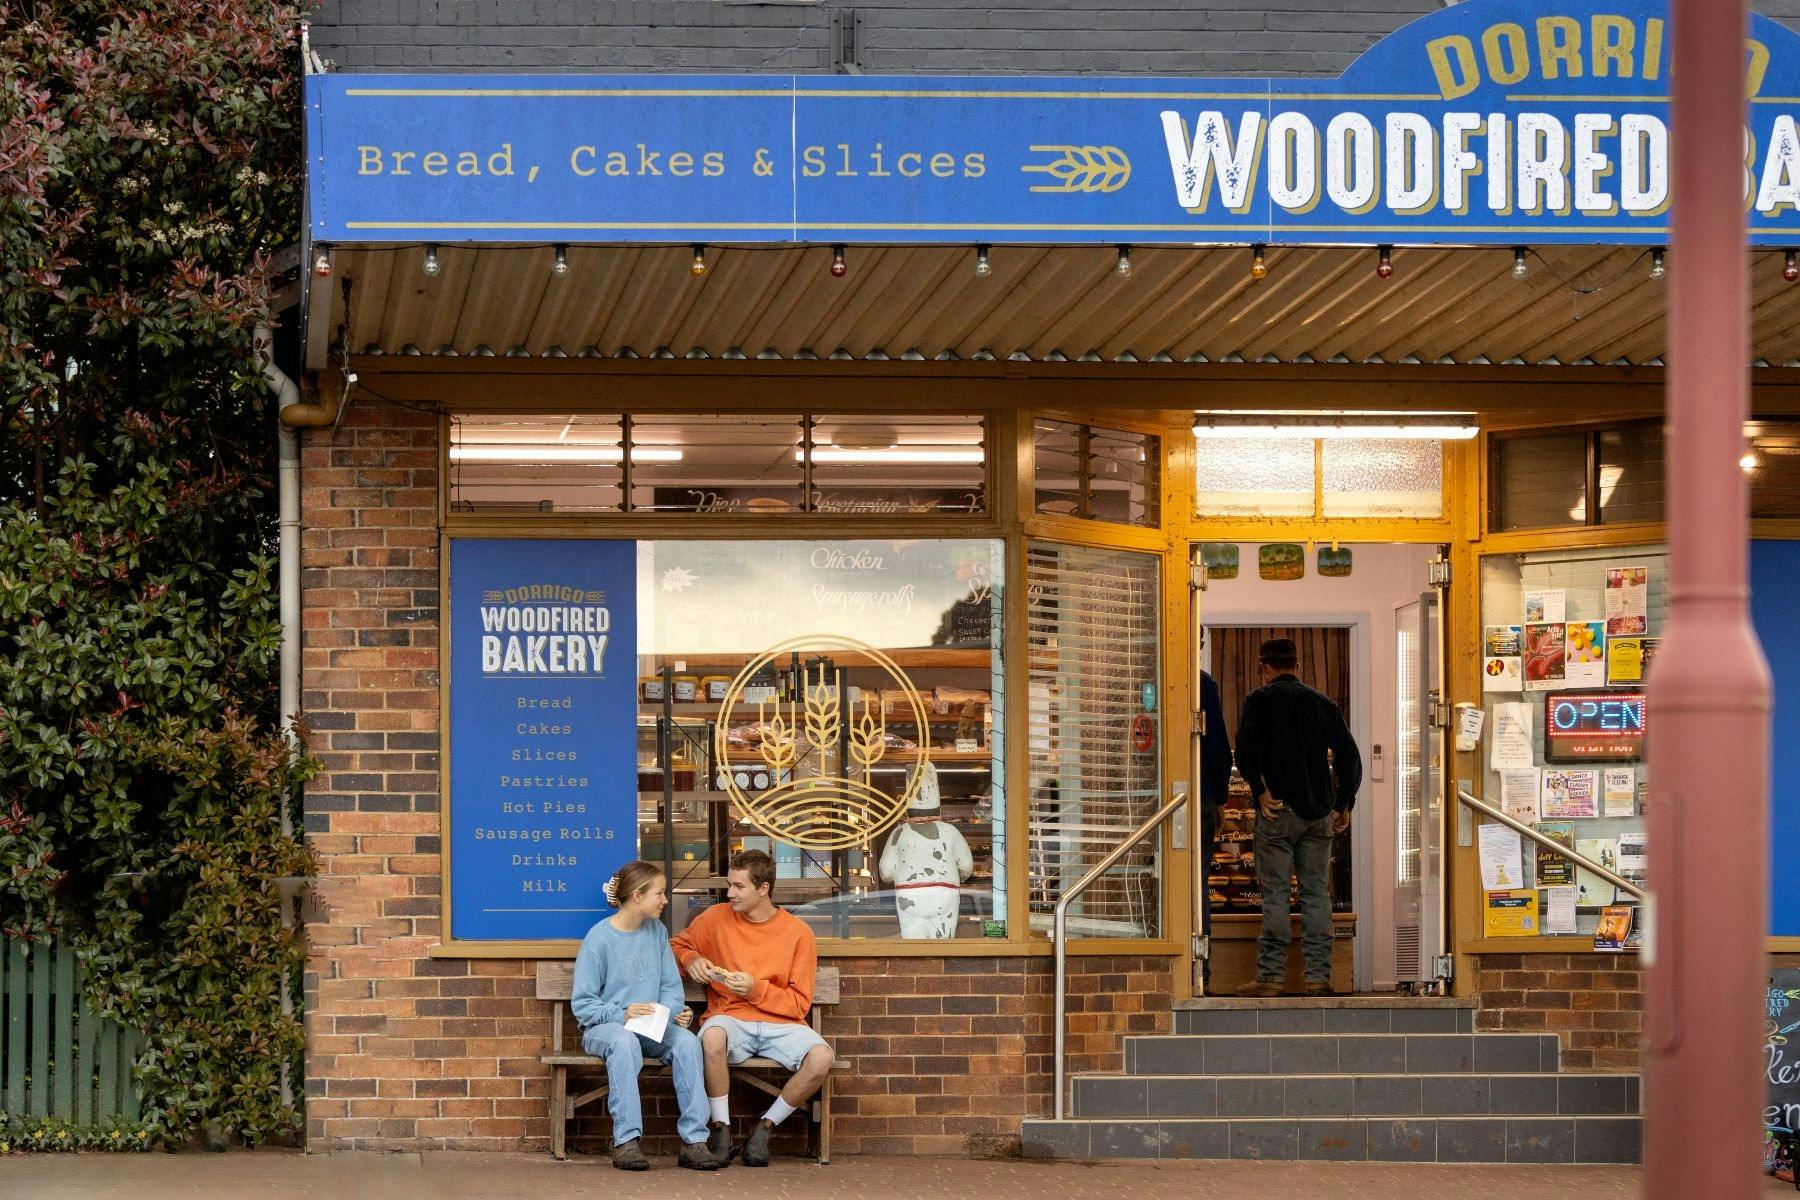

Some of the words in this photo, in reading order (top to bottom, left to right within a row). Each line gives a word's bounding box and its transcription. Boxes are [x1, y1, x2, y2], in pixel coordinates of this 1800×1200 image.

[358, 143, 540, 183] Bread,
[570, 143, 725, 177] Cakes
[753, 148, 774, 177] &
[802, 143, 987, 178] Slices
[1160, 110, 1668, 213] WOODFIRED
[811, 547, 889, 570] Chicken
[505, 584, 585, 604] DORRIGO
[480, 606, 610, 633] WOODFIRED
[482, 635, 609, 673] BAKERY
[516, 696, 573, 710] Bread
[1553, 701, 1643, 729] OPEN
[516, 722, 573, 736] Cakes
[511, 748, 578, 762] Slices
[500, 775, 589, 788] Pastries
[502, 802, 535, 814] Hot
[543, 801, 587, 814] Pies
[475, 827, 553, 843] Sausage
[560, 827, 615, 841] Rolls
[512, 853, 578, 867] Drinks
[523, 879, 567, 893] Milk
